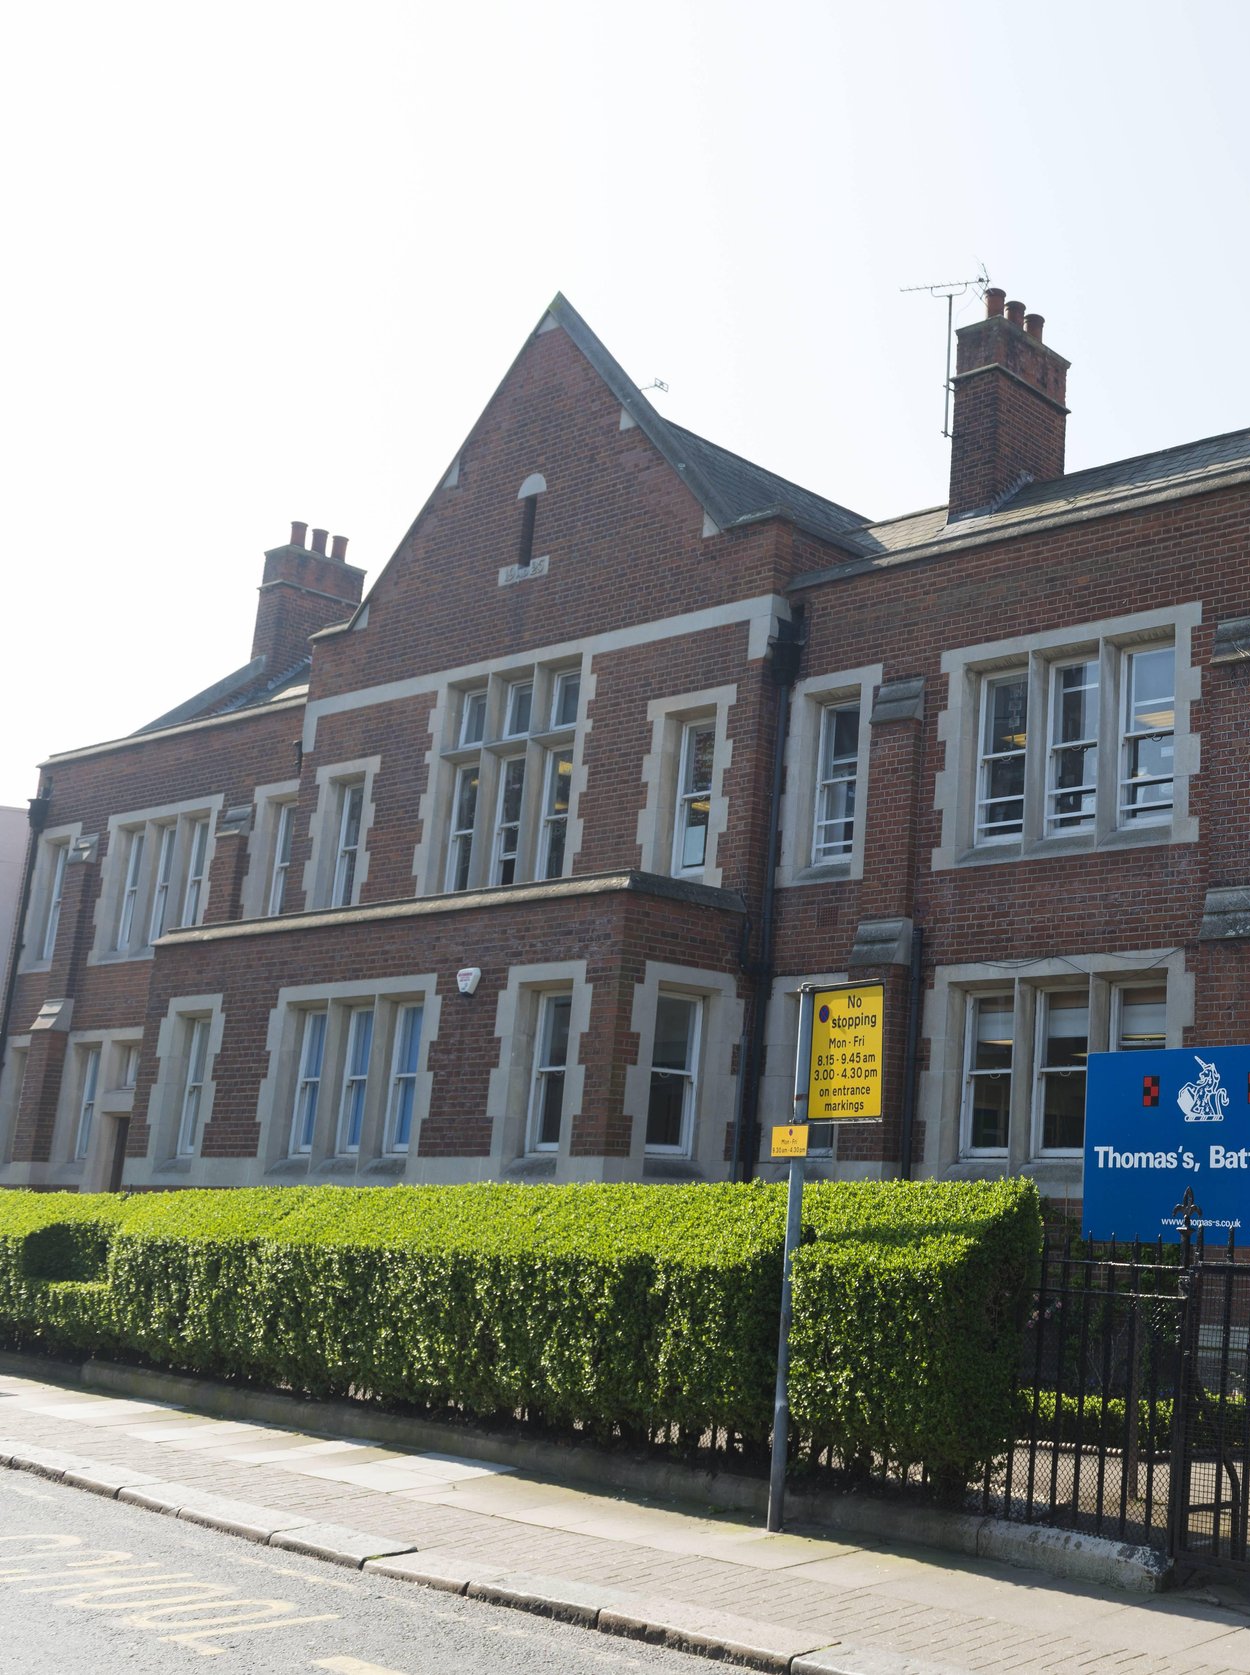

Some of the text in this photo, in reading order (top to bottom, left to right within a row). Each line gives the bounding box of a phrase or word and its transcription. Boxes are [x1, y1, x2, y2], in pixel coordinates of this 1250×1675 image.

[848, 994, 862, 1008] No
[832, 1012, 876, 1030] stopping
[829, 1038, 846, 1049] Mon
[854, 1036, 865, 1047] Fri
[818, 1054, 834, 1066] 8.15
[841, 1052, 861, 1064] 9.45
[814, 1069, 835, 1081] 3.00
[841, 1067, 862, 1080] 4.30
[820, 1085, 870, 1097] on entrance
[824, 1100, 864, 1112] markings
[1094, 1146, 1200, 1172] Thomas's,
